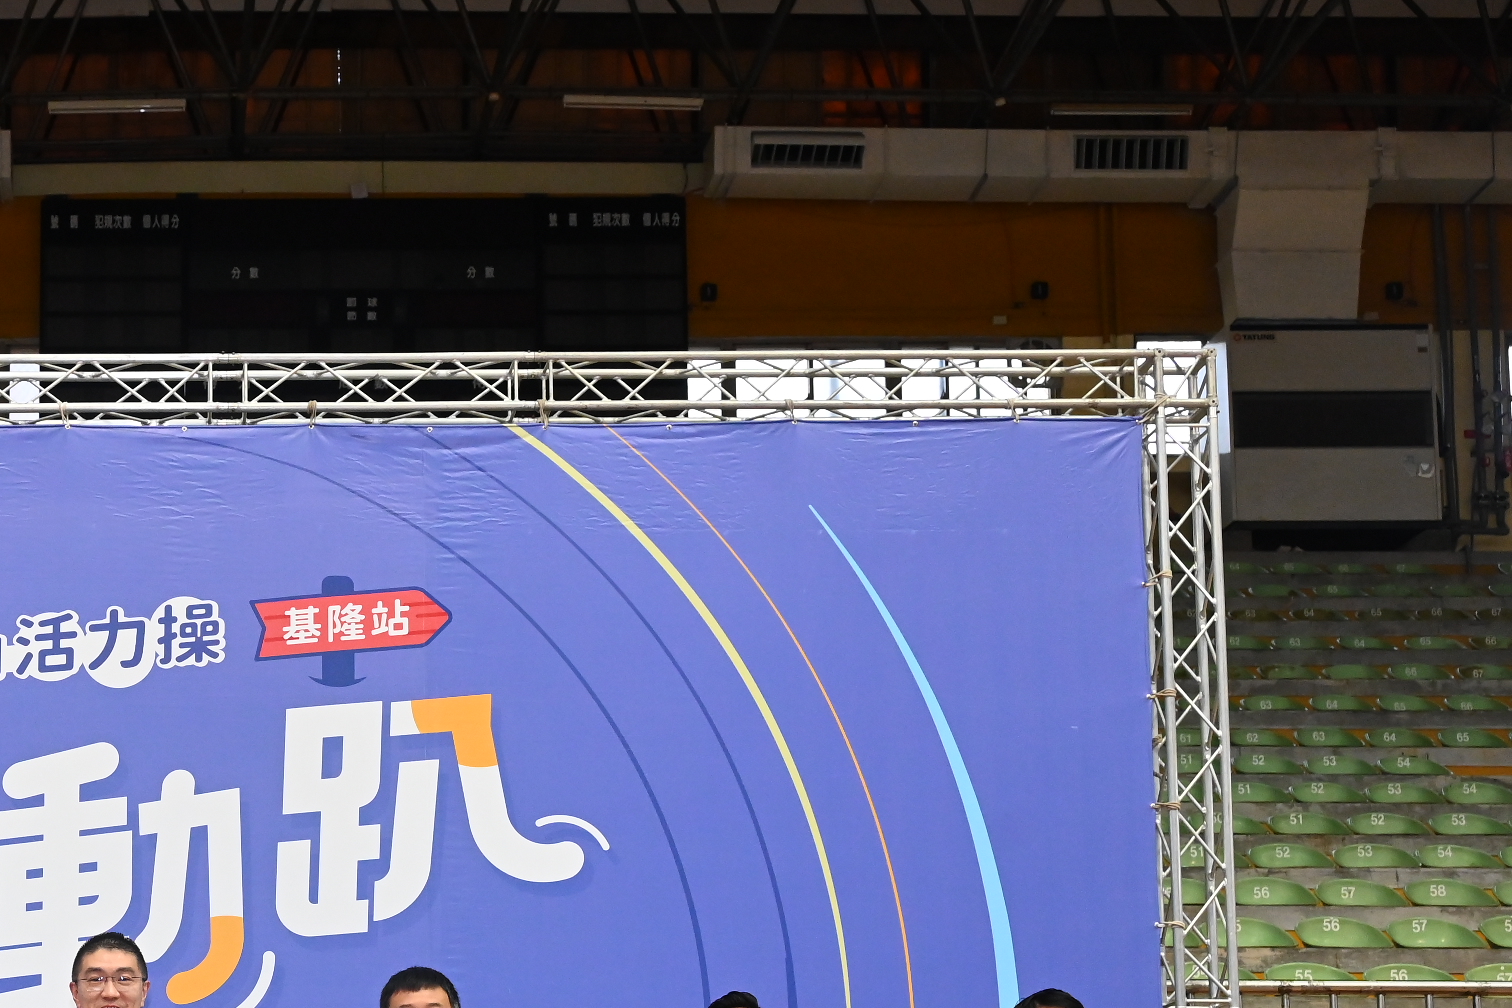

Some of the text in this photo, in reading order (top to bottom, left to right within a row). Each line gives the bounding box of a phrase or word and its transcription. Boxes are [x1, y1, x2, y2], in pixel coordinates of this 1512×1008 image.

[282, 599, 412, 647] 基隆站
[1260, 700, 1272, 710] 63
[1326, 699, 1338, 709] 64
[1246, 733, 1259, 743] 62
[1312, 731, 1325, 742] 63
[1383, 732, 1396, 742] 64
[1456, 732, 1469, 742] 65
[1252, 755, 1265, 765] 52
[1323, 756, 1336, 766] 53
[1397, 757, 1411, 768] 54
[1238, 783, 1250, 795] 51
[1311, 782, 1325, 794] 52
[1388, 783, 1402, 795] 53
[1462, 783, 1477, 794] 54
[1290, 813, 1302, 825] 51
[1371, 813, 1385, 825] 52
[1451, 814, 1466, 826] 53
[1276, 846, 1291, 858] 52
[1357, 844, 1373, 857] 53
[1438, 845, 1454, 858] 54
[1254, 886, 1270, 899] 56
[1341, 887, 1355, 900] 57
[1430, 885, 1447, 897] 58
[1323, 916, 1340, 931] 56
[1412, 919, 1427, 933] 57
[1294, 969, 1313, 980] 55
[1390, 969, 1408, 980] 56
